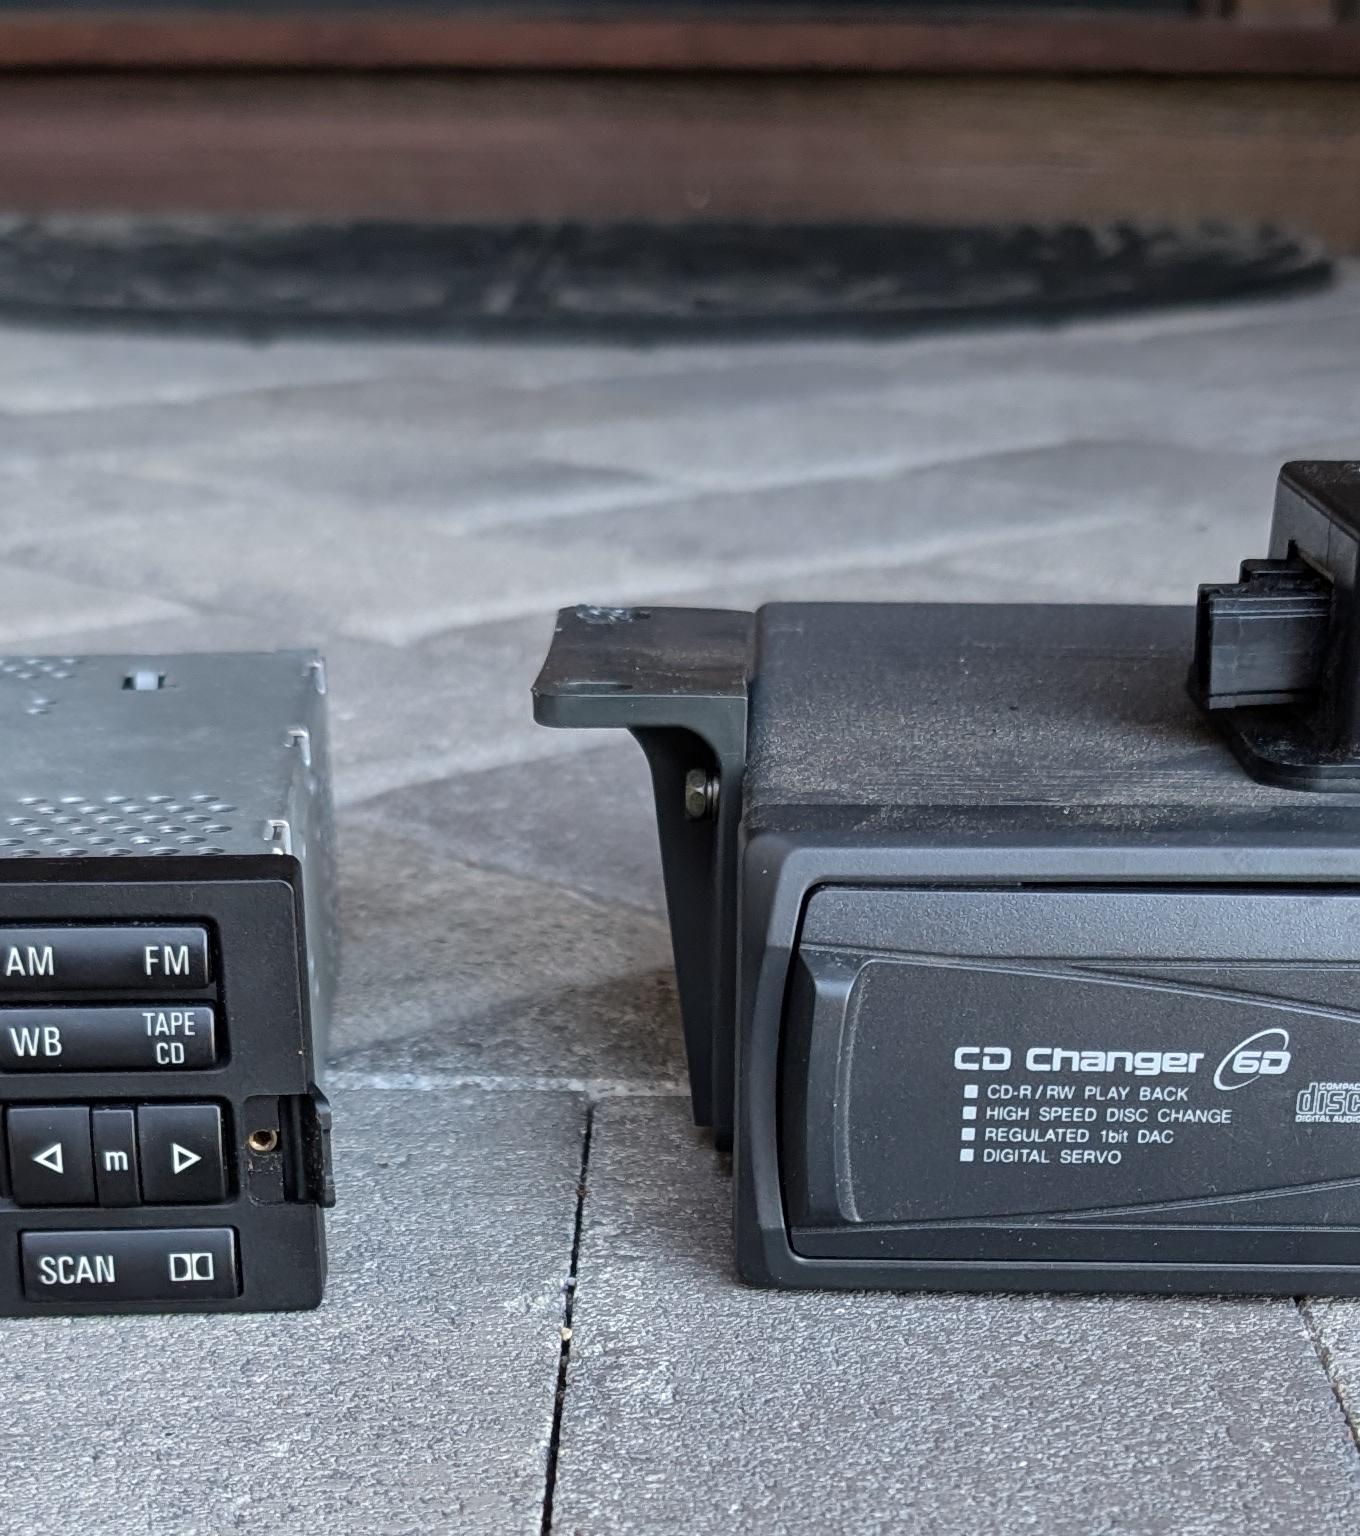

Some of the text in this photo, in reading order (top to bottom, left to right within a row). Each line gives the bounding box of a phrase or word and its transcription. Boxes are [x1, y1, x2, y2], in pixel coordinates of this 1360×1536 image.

[4, 945, 55, 977] AM
[143, 944, 191, 977] FM
[141, 1011, 196, 1037] TAPE
[8, 1026, 63, 1058] WB
[155, 1041, 186, 1066] CD
[953, 1045, 1205, 1076] CD Changer
[1083, 1084, 1132, 1102] PLAY
[1139, 1085, 1190, 1103] BACK
[985, 1106, 1233, 1124] HIGH SPEED DISC CHANGE
[1295, 1114, 1331, 1123] DIGITAL
[984, 1127, 1175, 1145] REGULATED 1bit DAC
[103, 1150, 129, 1173] m
[982, 1148, 1123, 1165] DIGITAL SERVO
[38, 1254, 116, 1286] SCAN
